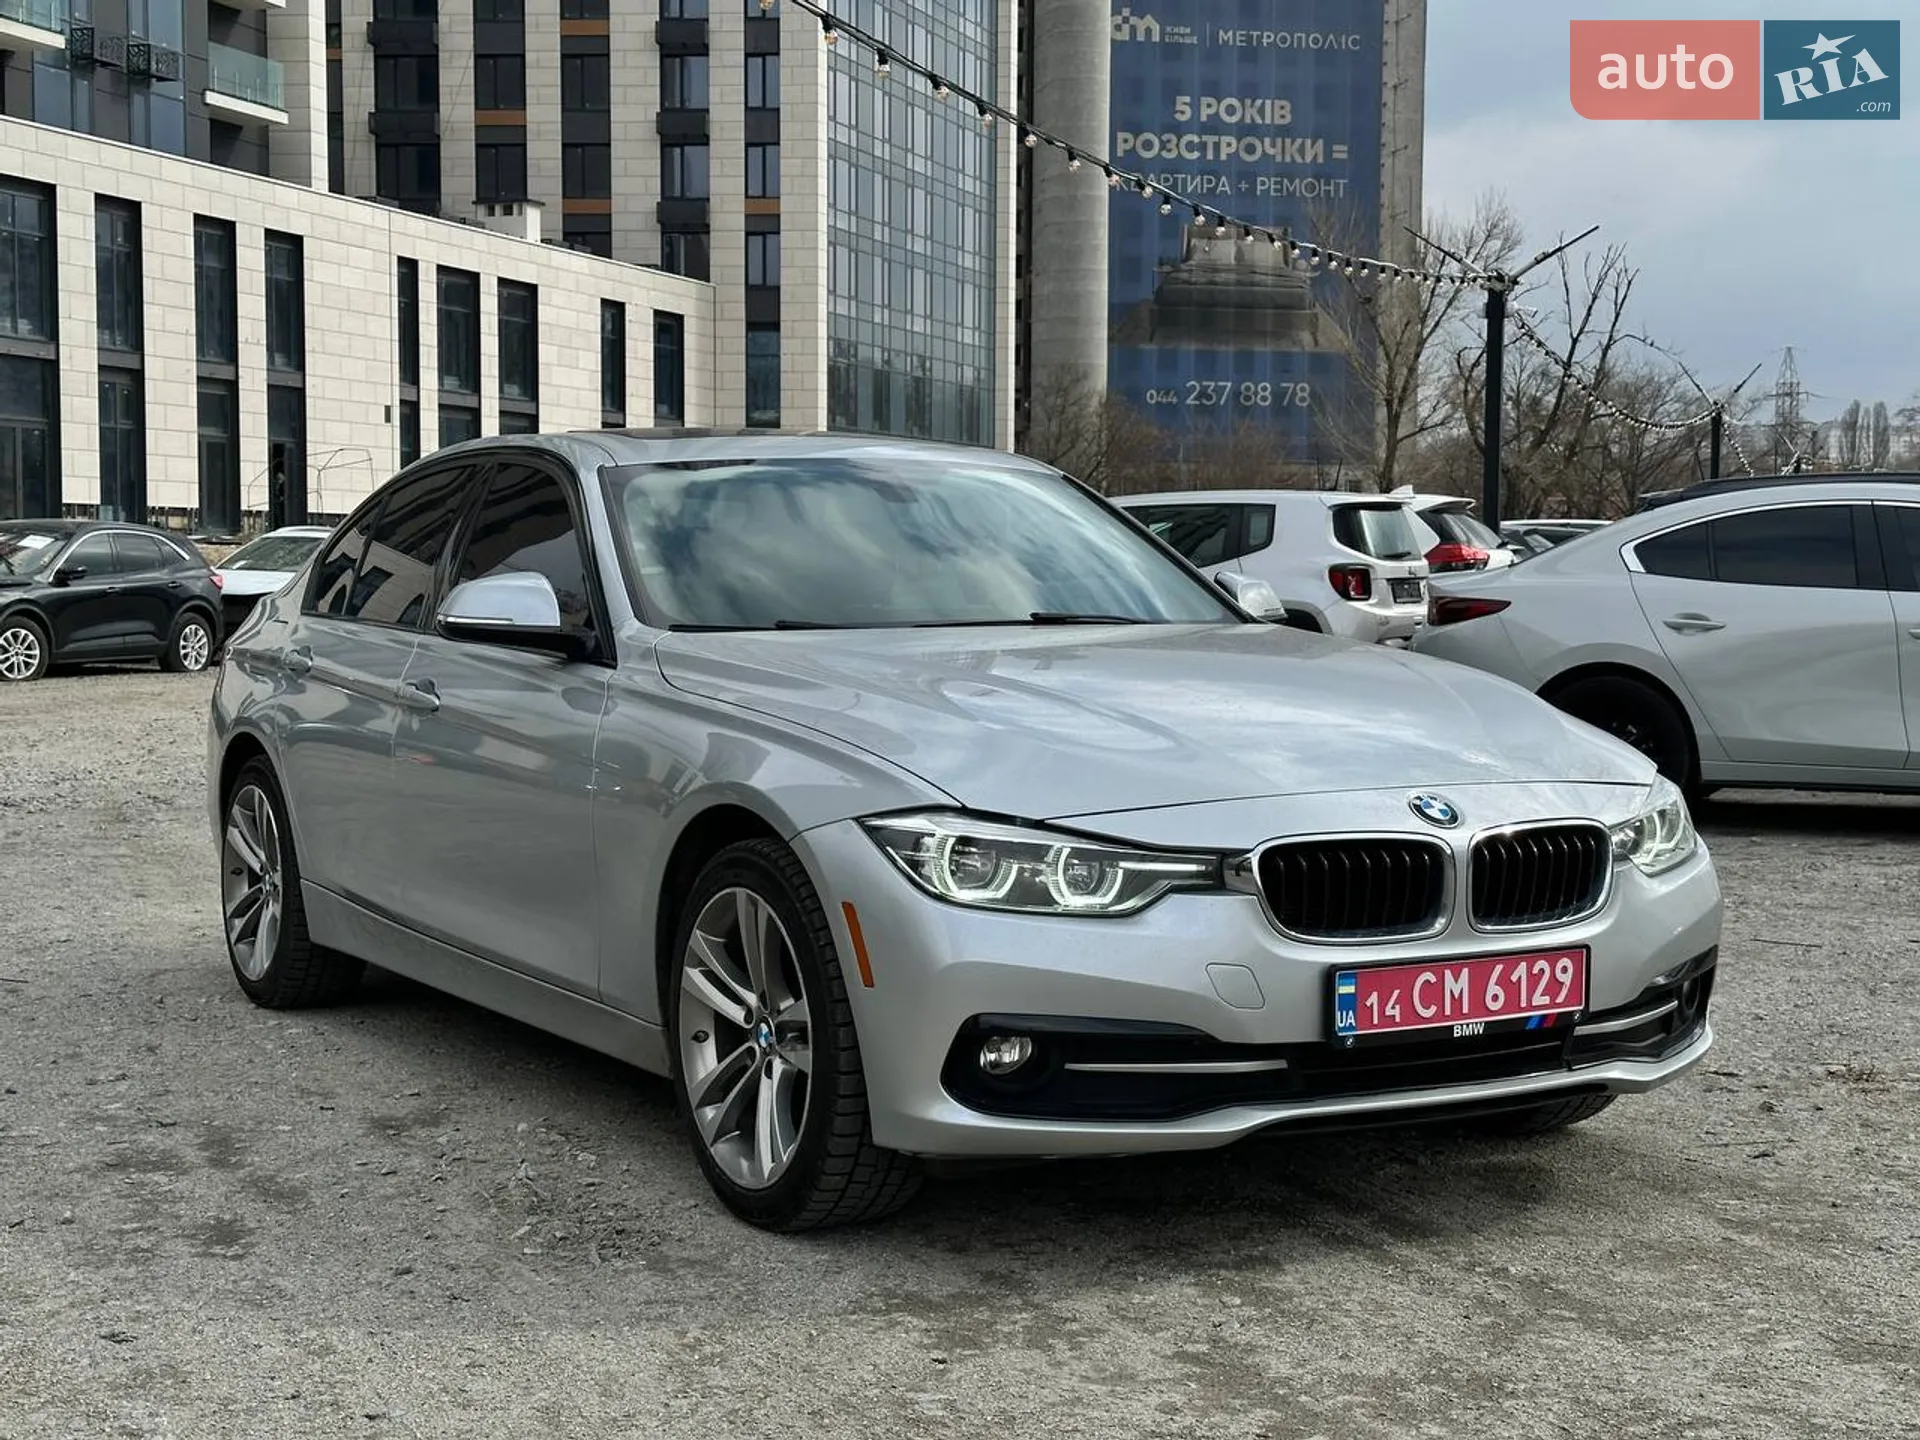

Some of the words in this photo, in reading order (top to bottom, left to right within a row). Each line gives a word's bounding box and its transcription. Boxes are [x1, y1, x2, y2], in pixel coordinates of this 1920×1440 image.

[1174, 96, 1192, 121] 5
[1200, 97, 1292, 125] РОКІВ
[1116, 132, 1324, 164] РОЗСТРОЧКИ
[1256, 177, 1348, 199] РЕМОНТ
[1186, 380, 1232, 406] 237
[1240, 382, 1272, 406] 88
[1280, 383, 1310, 407] 78
[1365, 989, 1401, 1025] 14
[1485, 957, 1574, 1011] 6129
[1337, 1010, 1355, 1028] UA
[1453, 1022, 1485, 1037] BMW
